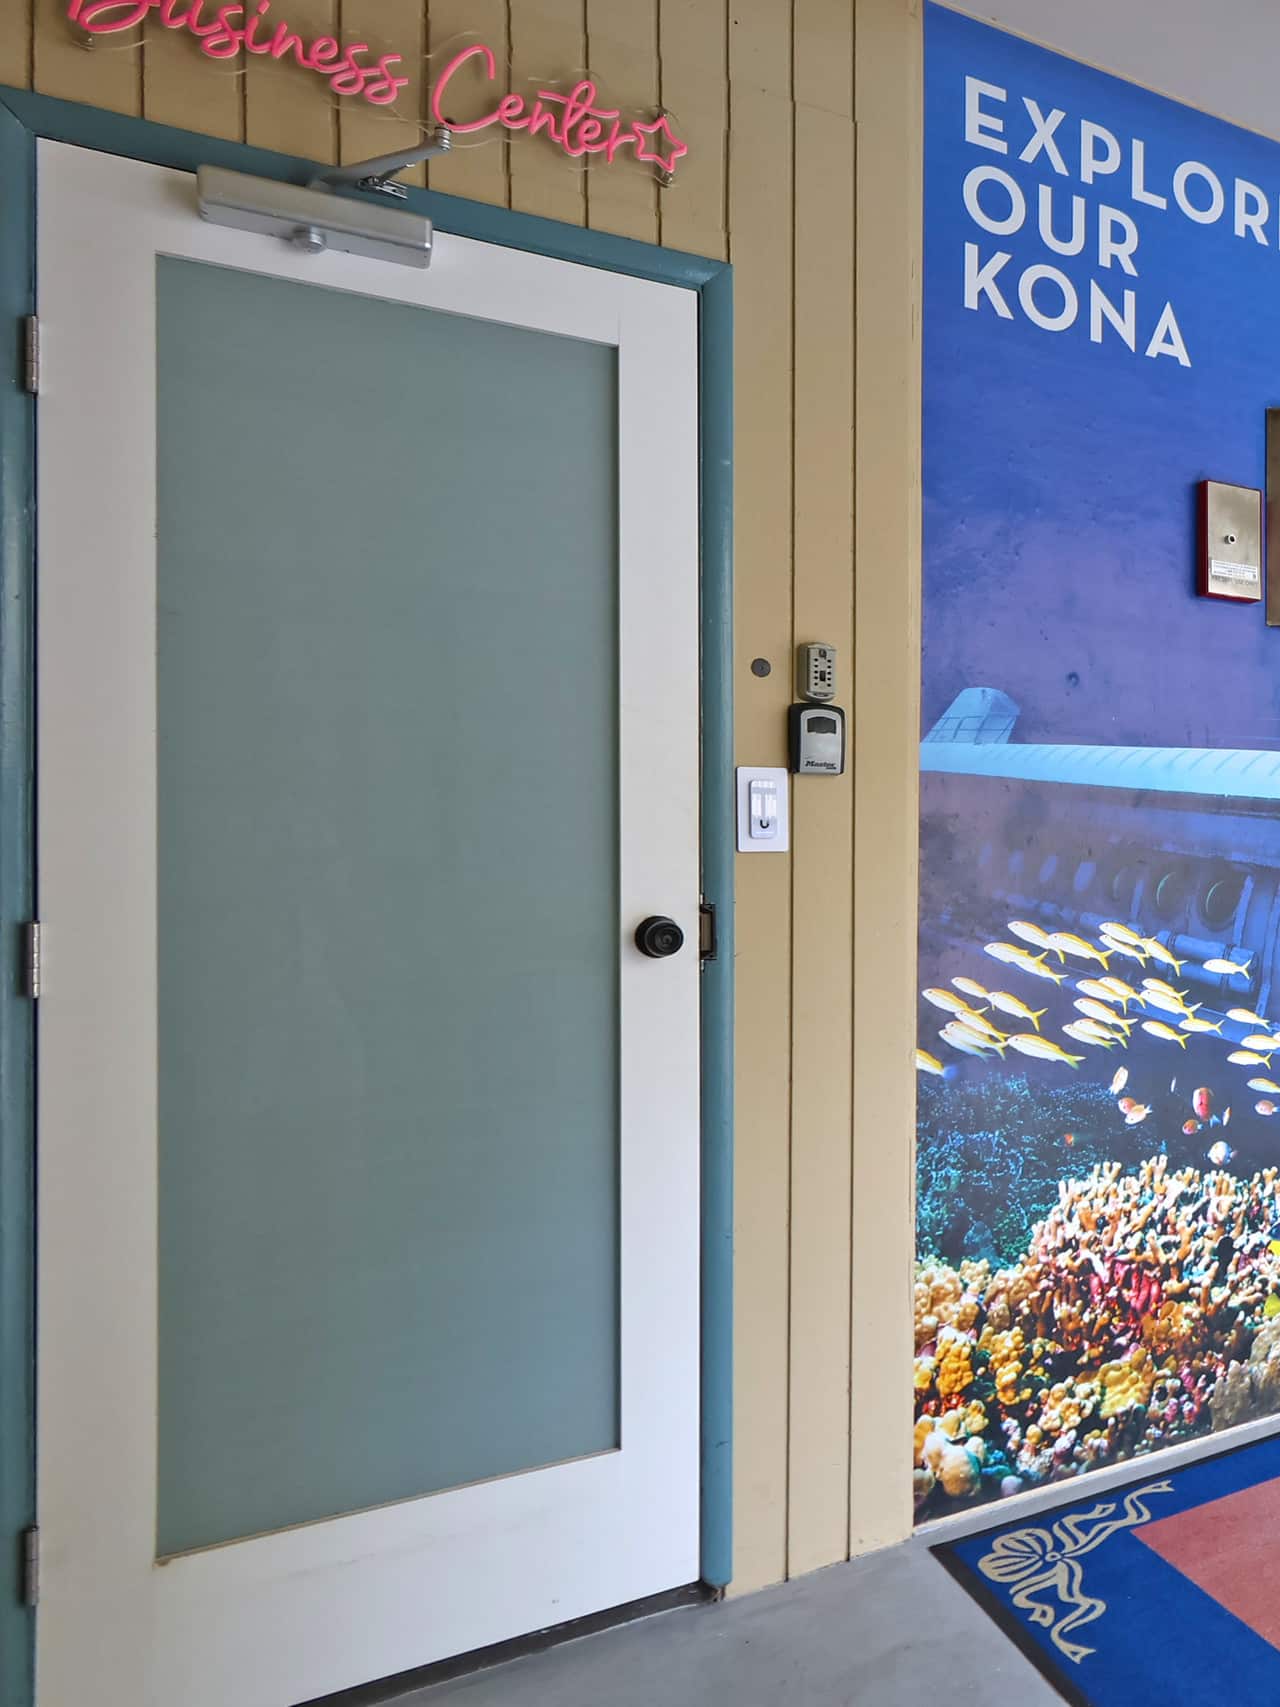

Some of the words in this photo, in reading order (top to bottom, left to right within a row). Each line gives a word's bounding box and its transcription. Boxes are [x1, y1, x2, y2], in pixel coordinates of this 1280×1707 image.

[432, 44, 637, 164] Center
[962, 165, 1139, 277] OUR
[964, 242, 1192, 368] KONA
